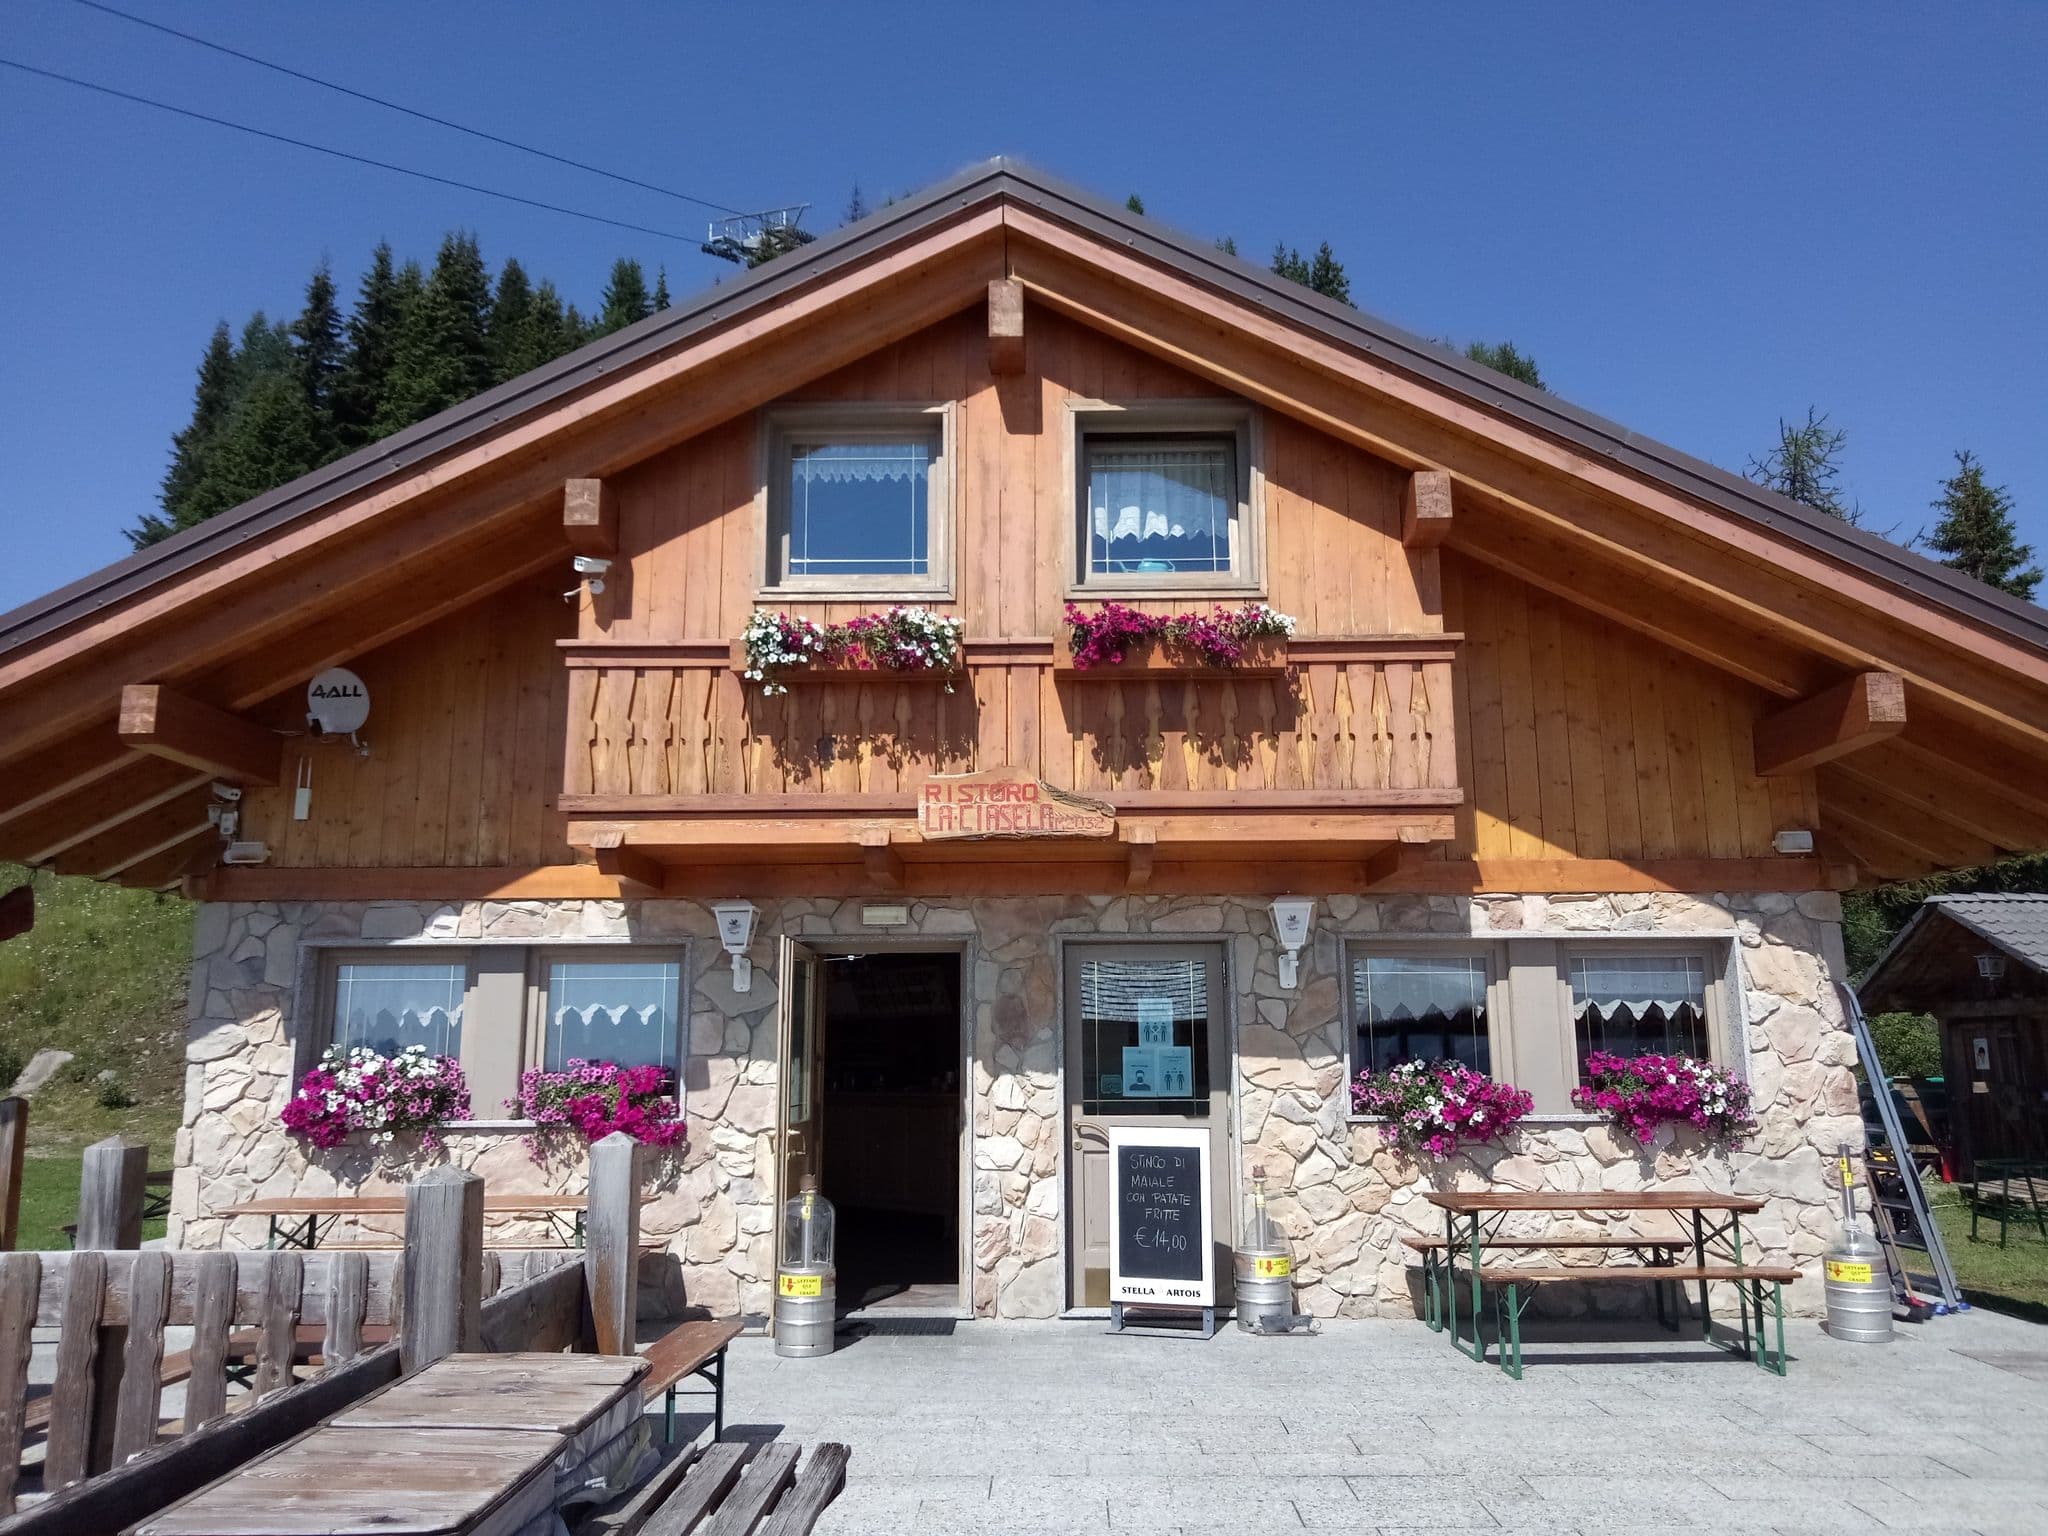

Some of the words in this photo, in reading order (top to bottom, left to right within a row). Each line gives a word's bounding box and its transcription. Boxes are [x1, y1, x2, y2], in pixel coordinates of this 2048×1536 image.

[925, 783, 1039, 803] RISTORO
[960, 803, 1054, 832] CIASELA
[1130, 1153, 1166, 1169] STINCO
[1173, 1156, 1185, 1168] DI
[1131, 1174, 1175, 1188] MAIALE
[1126, 1192, 1145, 1203] CON
[1151, 1192, 1191, 1206] PATATE
[1145, 1207, 1180, 1221] FRITTE
[1121, 1286, 1155, 1295] STELLA
[1166, 1288, 1201, 1298] ARTOIS
